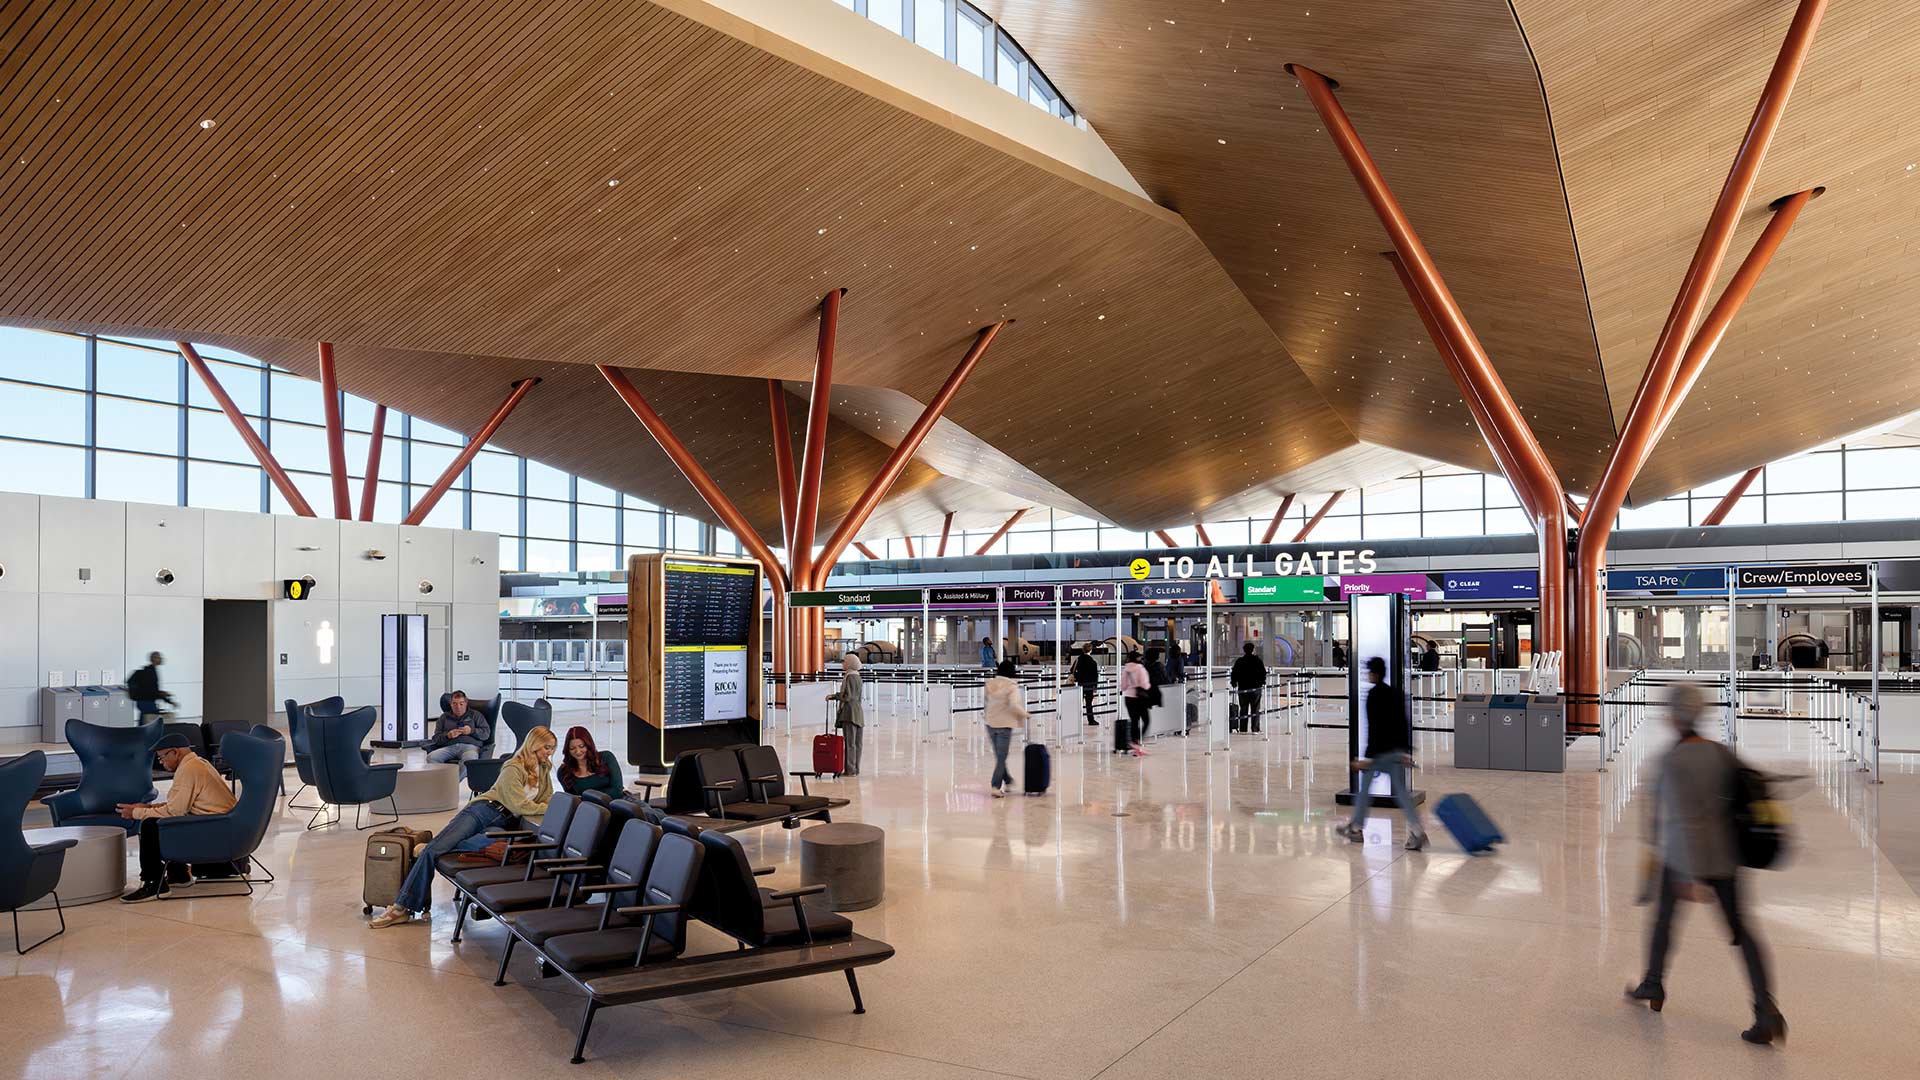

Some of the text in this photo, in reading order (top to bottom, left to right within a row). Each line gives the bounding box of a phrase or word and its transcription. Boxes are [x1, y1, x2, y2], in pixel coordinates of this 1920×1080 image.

[1158, 549, 1378, 579] TO ALL GATES
[1634, 575, 1679, 587] TSA Pre
[1742, 570, 1863, 586] Crew/Employees
[1072, 587, 1105, 600] Priority
[1247, 585, 1276, 594] Standard
[1344, 583, 1370, 593] Priority
[838, 593, 871, 603] Standard
[942, 592, 965, 601] Assisted
[969, 590, 990, 602] Military
[1014, 589, 1045, 602] Priority
